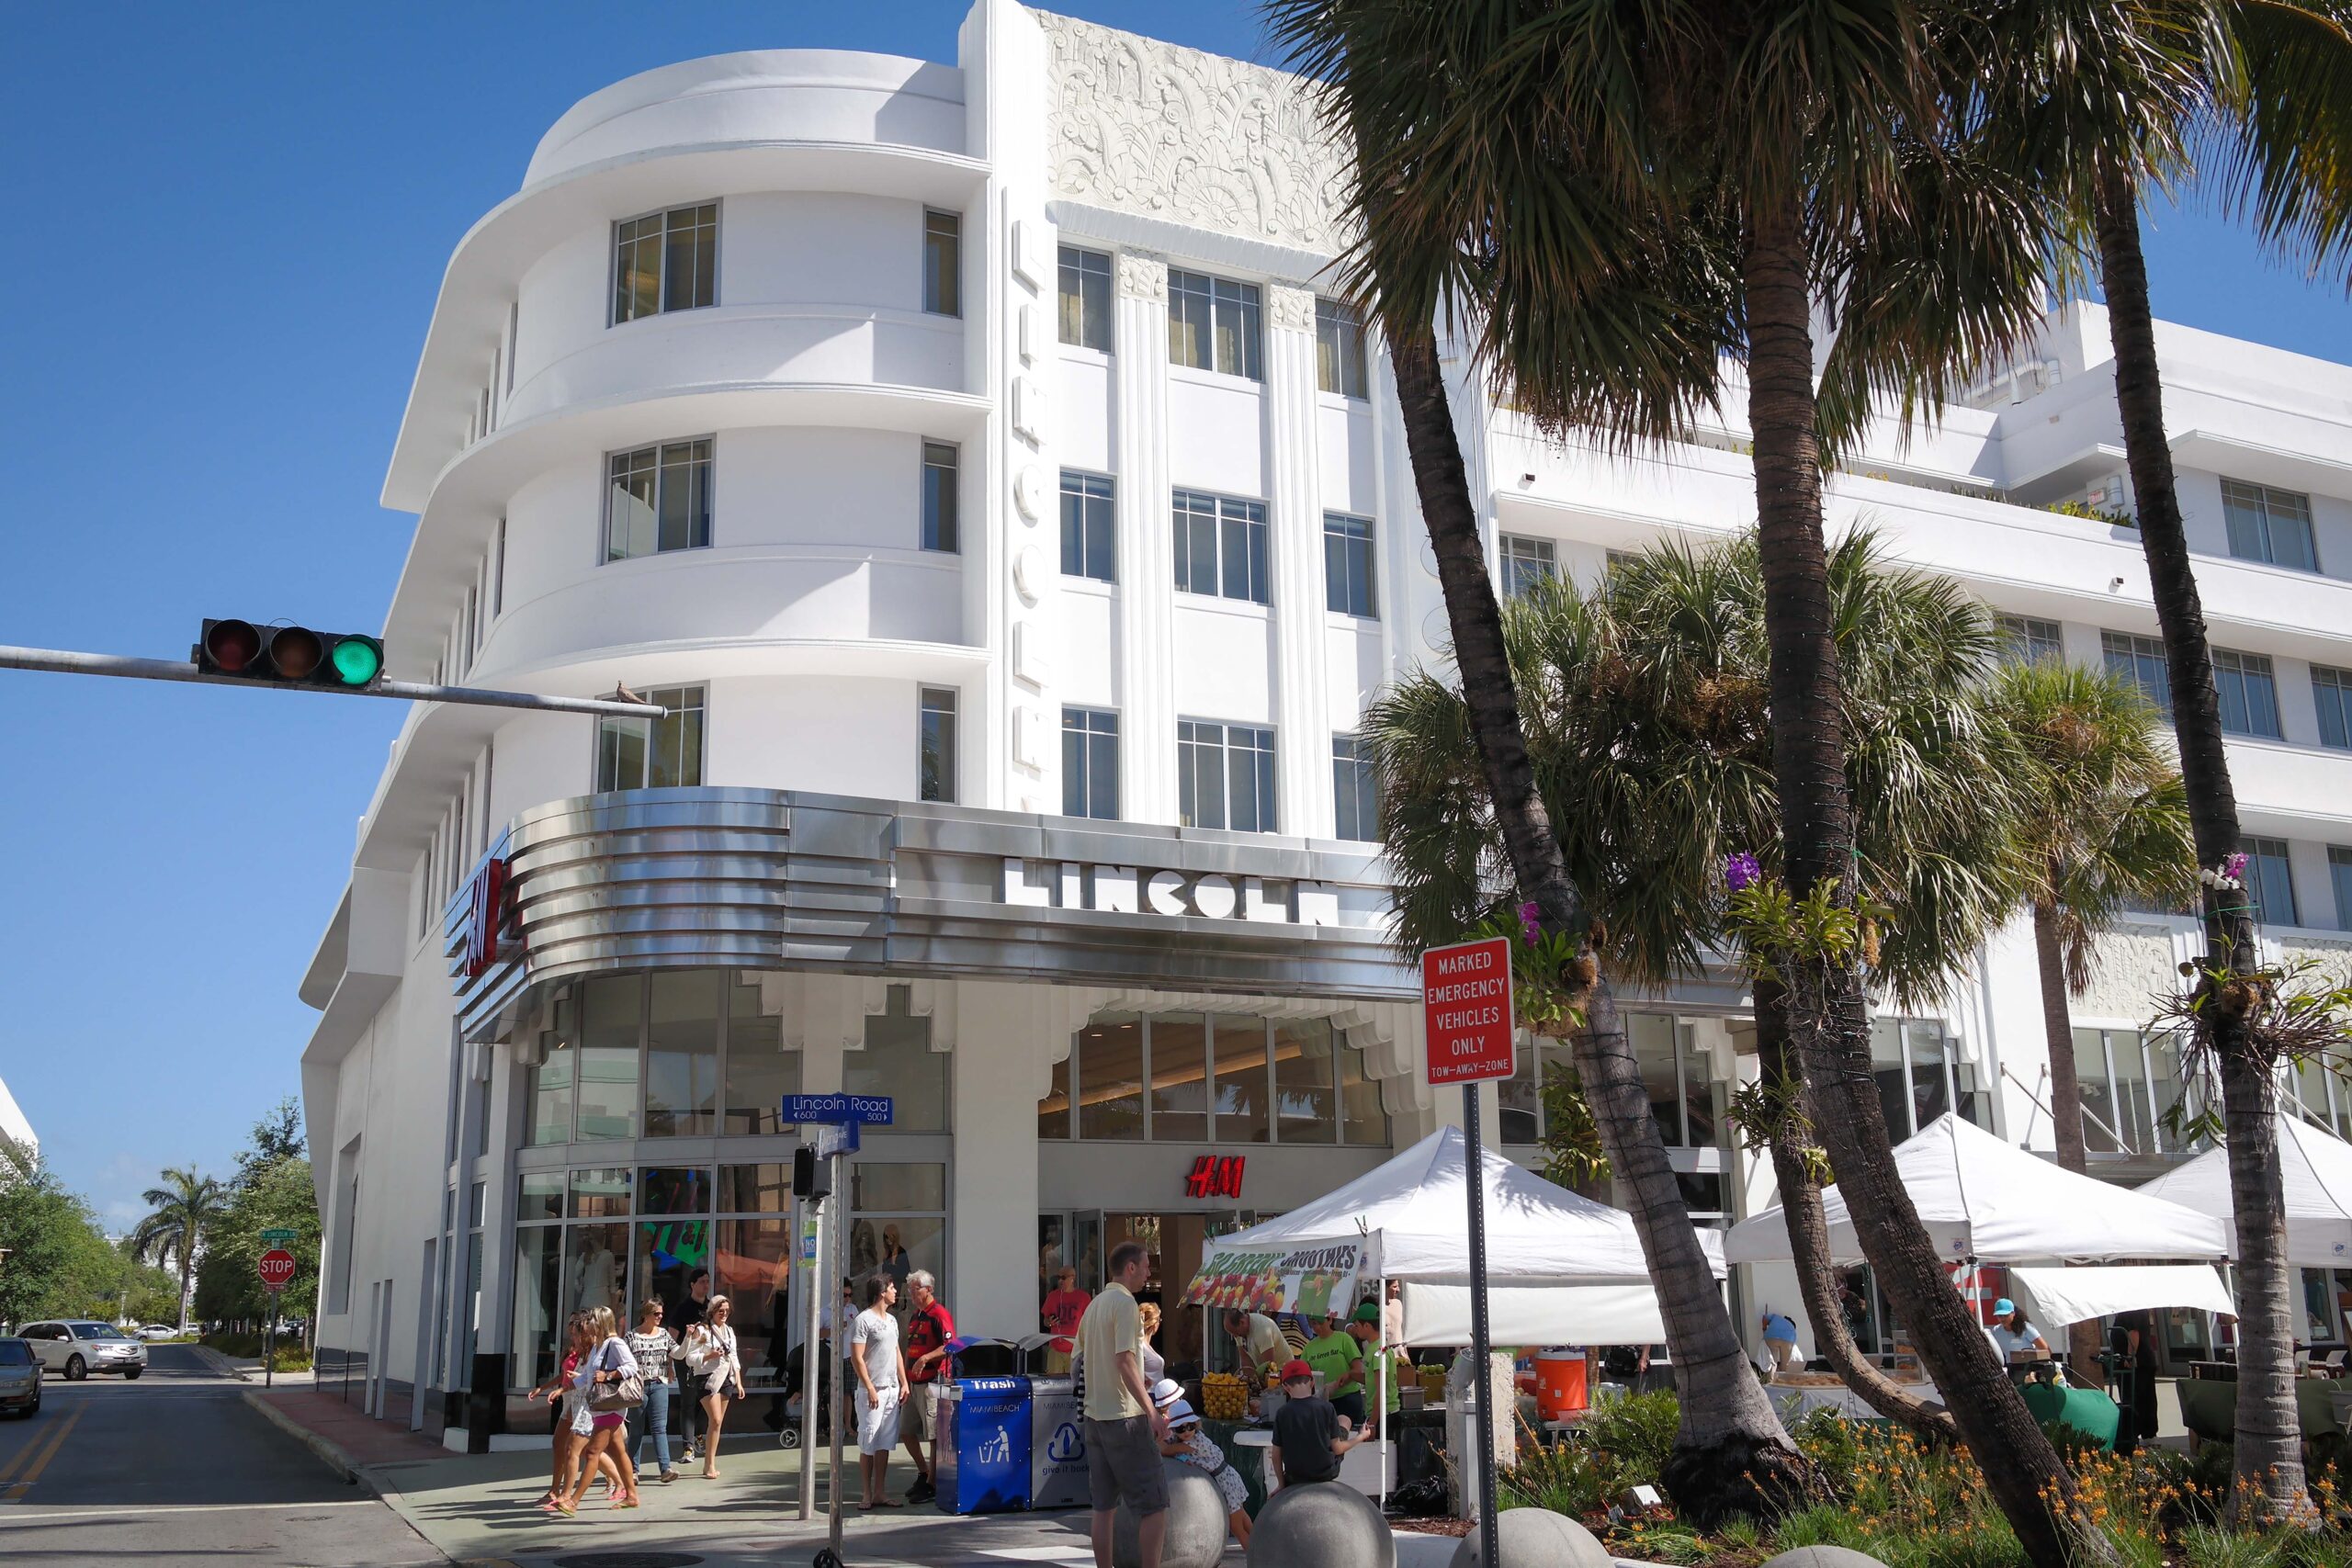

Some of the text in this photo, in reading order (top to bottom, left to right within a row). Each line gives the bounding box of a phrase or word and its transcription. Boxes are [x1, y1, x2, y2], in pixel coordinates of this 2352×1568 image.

[1012, 220, 1050, 774] LINCOLN
[1002, 856, 1339, 926] LINCOLN
[1438, 952, 1492, 976] MARKED
[1428, 977, 1505, 1005] EMERGENCY
[1436, 1006, 1499, 1031] VEHICLES
[1452, 1036, 1485, 1055] ONLY
[793, 1096, 888, 1112] Lincoln Road
[799, 1111, 882, 1122] 600 500
[1184, 1155, 1246, 1199] H&M
[261, 1260, 293, 1273] STOP
[1280, 1245, 1357, 1269] SMOOTHIES
[970, 1379, 1016, 1390] Trash
[1042, 1465, 1059, 1476] give
[1062, 1463, 1069, 1473] it
